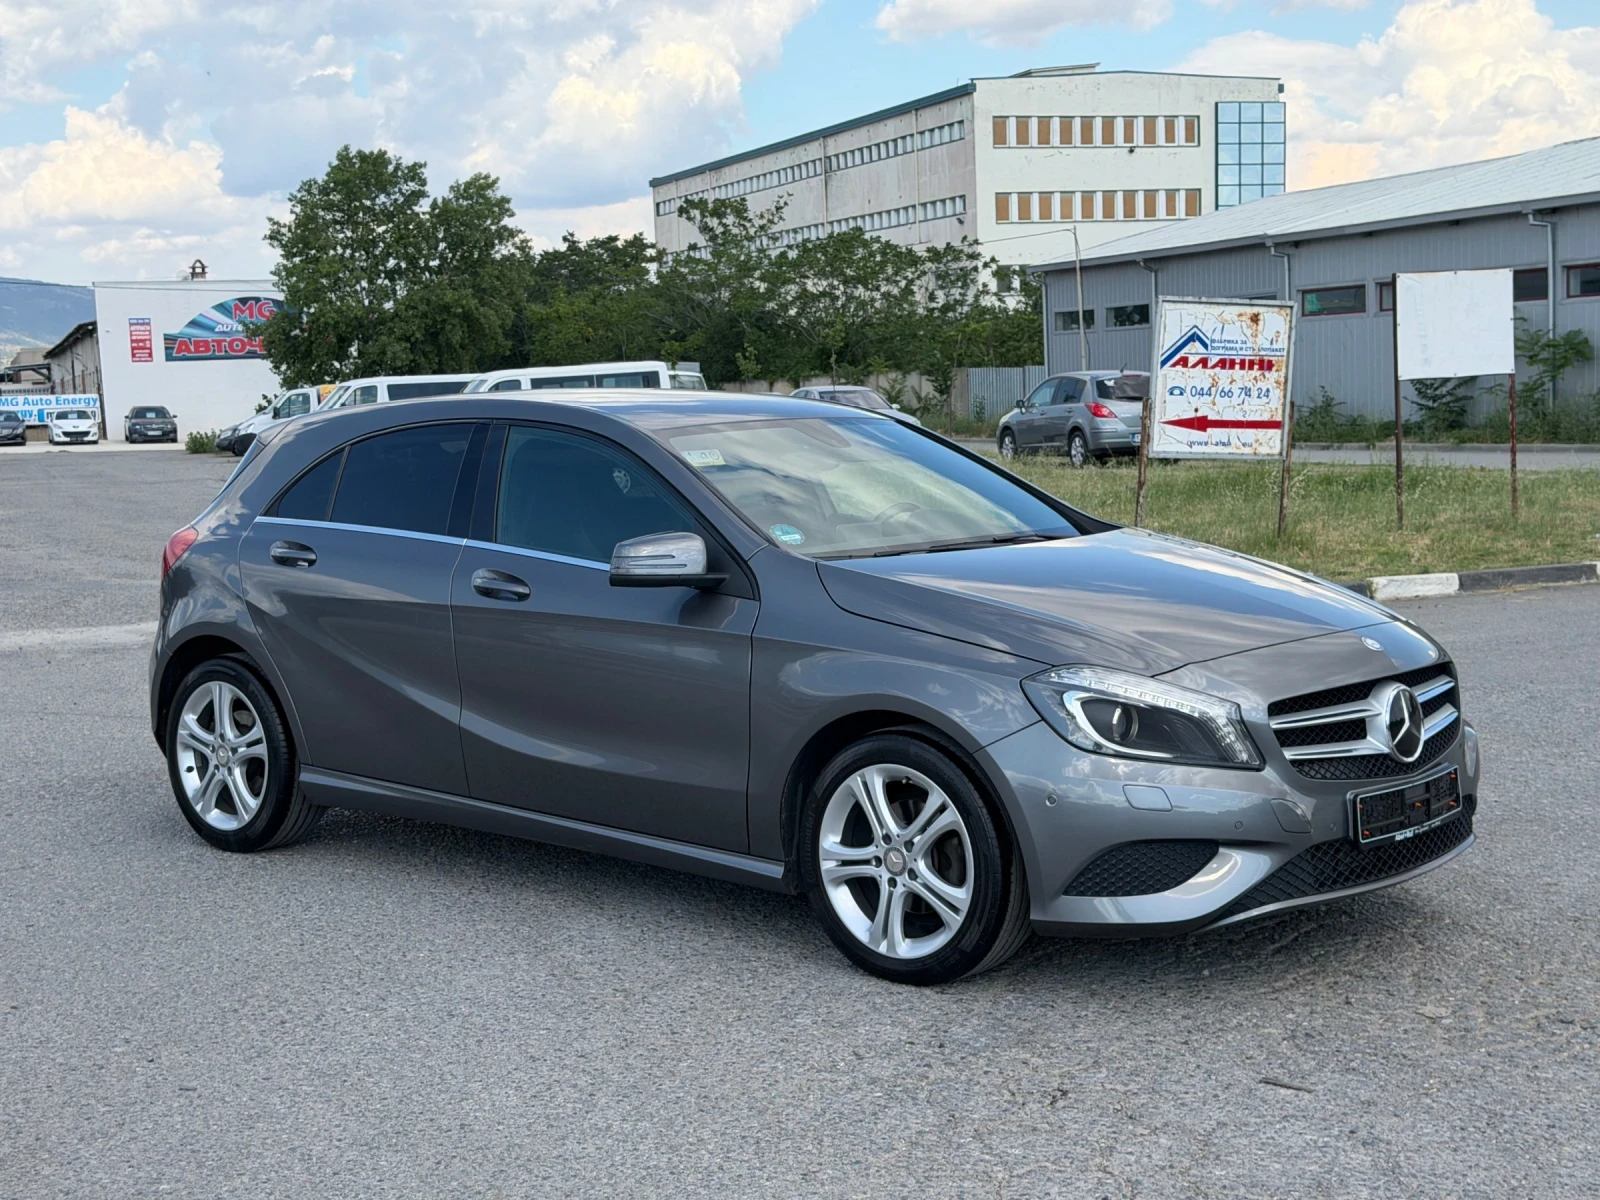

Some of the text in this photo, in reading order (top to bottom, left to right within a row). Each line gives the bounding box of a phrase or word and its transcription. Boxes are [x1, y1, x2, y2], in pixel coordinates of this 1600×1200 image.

[232, 300, 276, 320] MG
[174, 337, 267, 356] АВТОЧ
[22, 397, 53, 407] Auto
[55, 396, 98, 407] Energy
